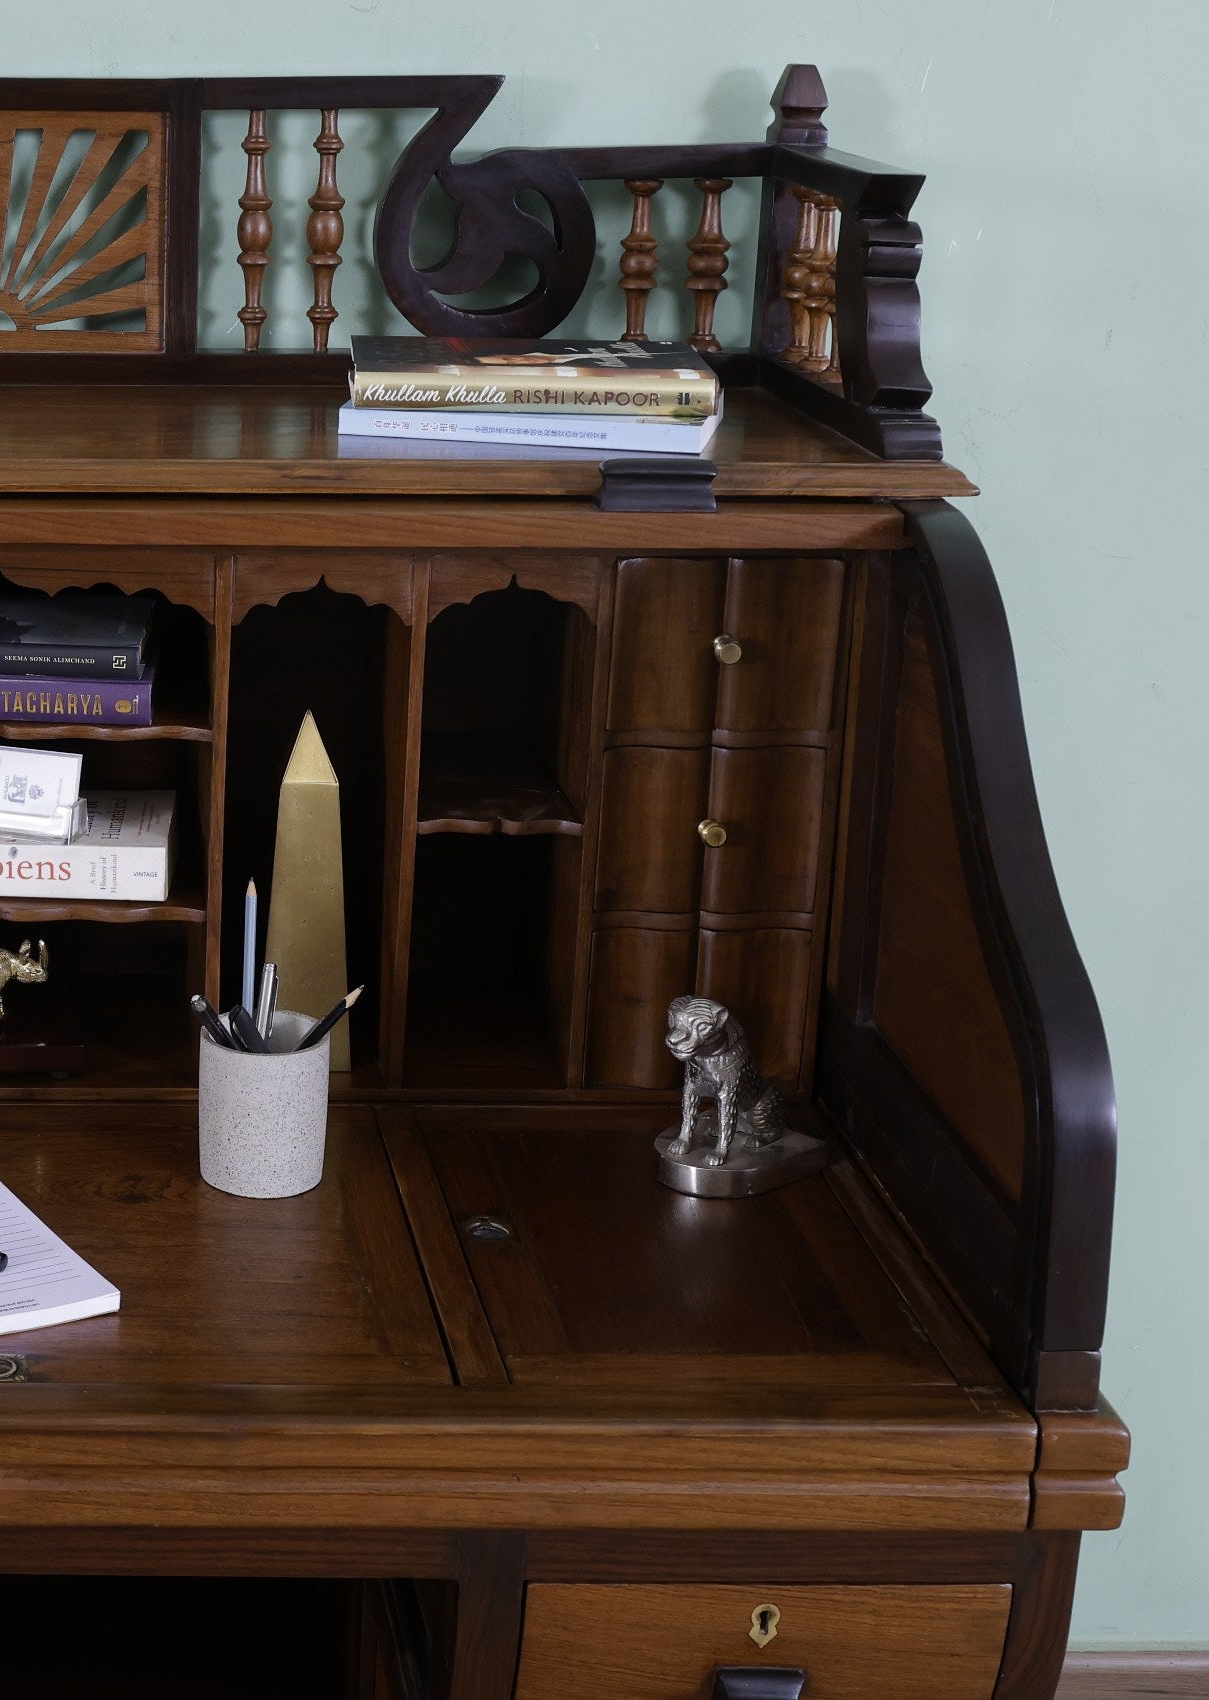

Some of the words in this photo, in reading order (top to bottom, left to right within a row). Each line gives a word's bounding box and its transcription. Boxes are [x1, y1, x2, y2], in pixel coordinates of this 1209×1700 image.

[363, 383, 441, 402] Khullam
[445, 383, 507, 404] Khulla
[513, 389, 565, 404] RISHI
[574, 391, 660, 407] KAPOOR
[99, 856, 107, 864] of
[99, 865, 108, 890] History
[110, 854, 118, 893] Humankind
